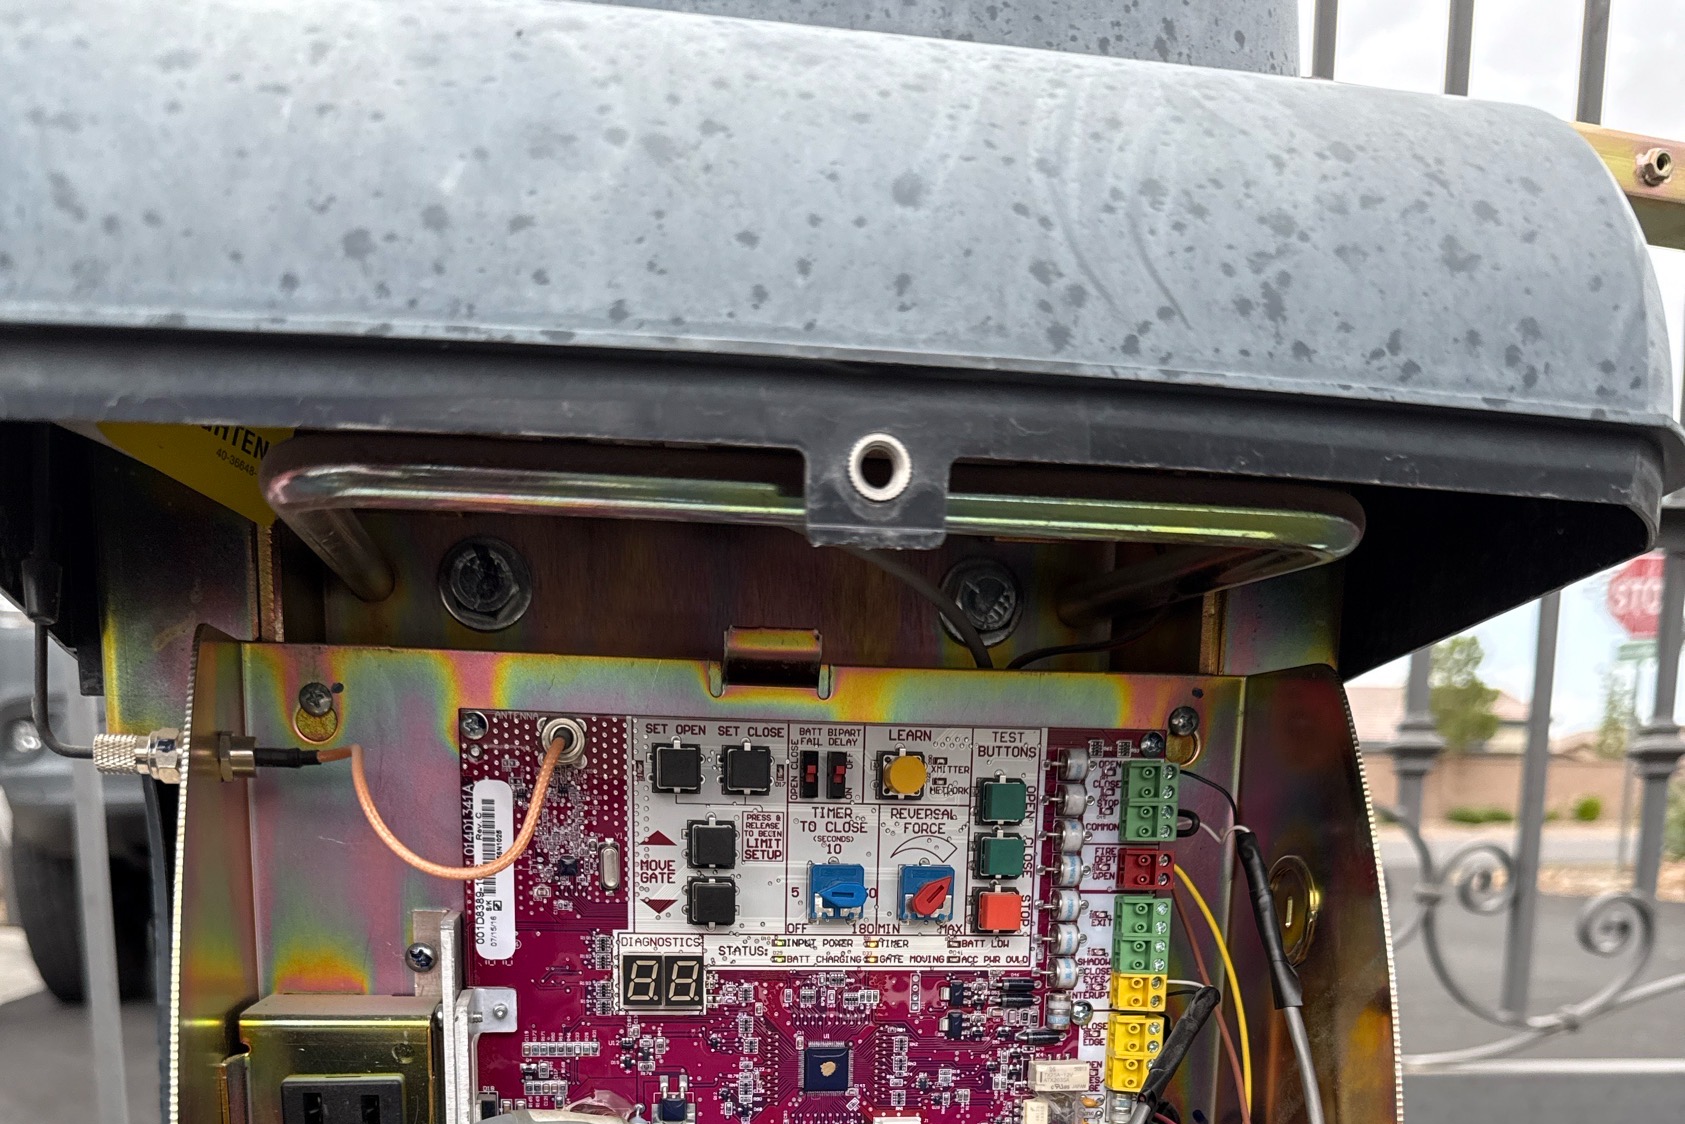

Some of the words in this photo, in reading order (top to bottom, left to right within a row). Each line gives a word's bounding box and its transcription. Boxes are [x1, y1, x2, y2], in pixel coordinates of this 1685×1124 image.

[646, 724, 668, 734] SET
[676, 725, 706, 735] OPEN
[718, 726, 740, 736] SET
[748, 727, 785, 738] CLOSE
[799, 728, 822, 736] BATT
[828, 728, 862, 737] BIPART
[889, 729, 932, 741] LEARN
[992, 731, 1025, 743] TEST
[801, 738, 822, 746] FAIL
[828, 738, 858, 746] DELAY
[791, 739, 799, 770] CLOSE
[978, 746, 1037, 758] BUTTONS
[931, 765, 970, 774] XMITTER
[790, 775, 799, 800] OPEN
[1093, 780, 1122, 788] CLOSE
[1026, 785, 1036, 818] OPEN
[812, 807, 853, 819] TIMER
[891, 808, 957, 820] REVERSAL
[475, 820, 483, 841] Rev.
[800, 821, 817, 832] TO
[825, 821, 868, 833] CLOSE
[904, 823, 946, 834] FORCE
[1086, 823, 1120, 831] COMMON
[746, 839, 781, 848] LIMIT
[827, 844, 842, 854] 10
[1095, 847, 1117, 855] FIRE
[745, 850, 782, 860] SETUP
[1022, 837, 1034, 878] CLOSE
[640, 859, 676, 871] MOVE
[640, 872, 676, 884] GATE
[1092, 872, 1115, 880] OPEN
[791, 887, 799, 898] 5
[1021, 894, 1031, 927] STOP
[1091, 919, 1112, 927] EXIT
[787, 923, 809, 934] OFF
[852, 924, 874, 934] 180
[878, 924, 900, 934] MIN
[940, 924, 962, 935] MAX
[621, 937, 700, 947] DIAGNOSTICS
[787, 939, 816, 947] INPUT
[822, 939, 853, 947] POWER
[962, 940, 986, 948] BATT
[991, 940, 1009, 948] LOW
[718, 946, 768, 956] STATUS:
[816, 956, 861, 964] CHARGING
[1077, 958, 1111, 966] SHADOW
[1083, 968, 1112, 976] CLOSE
[1072, 991, 1110, 999] NTERUPT
[1083, 1038, 1105, 1046] EDGE
